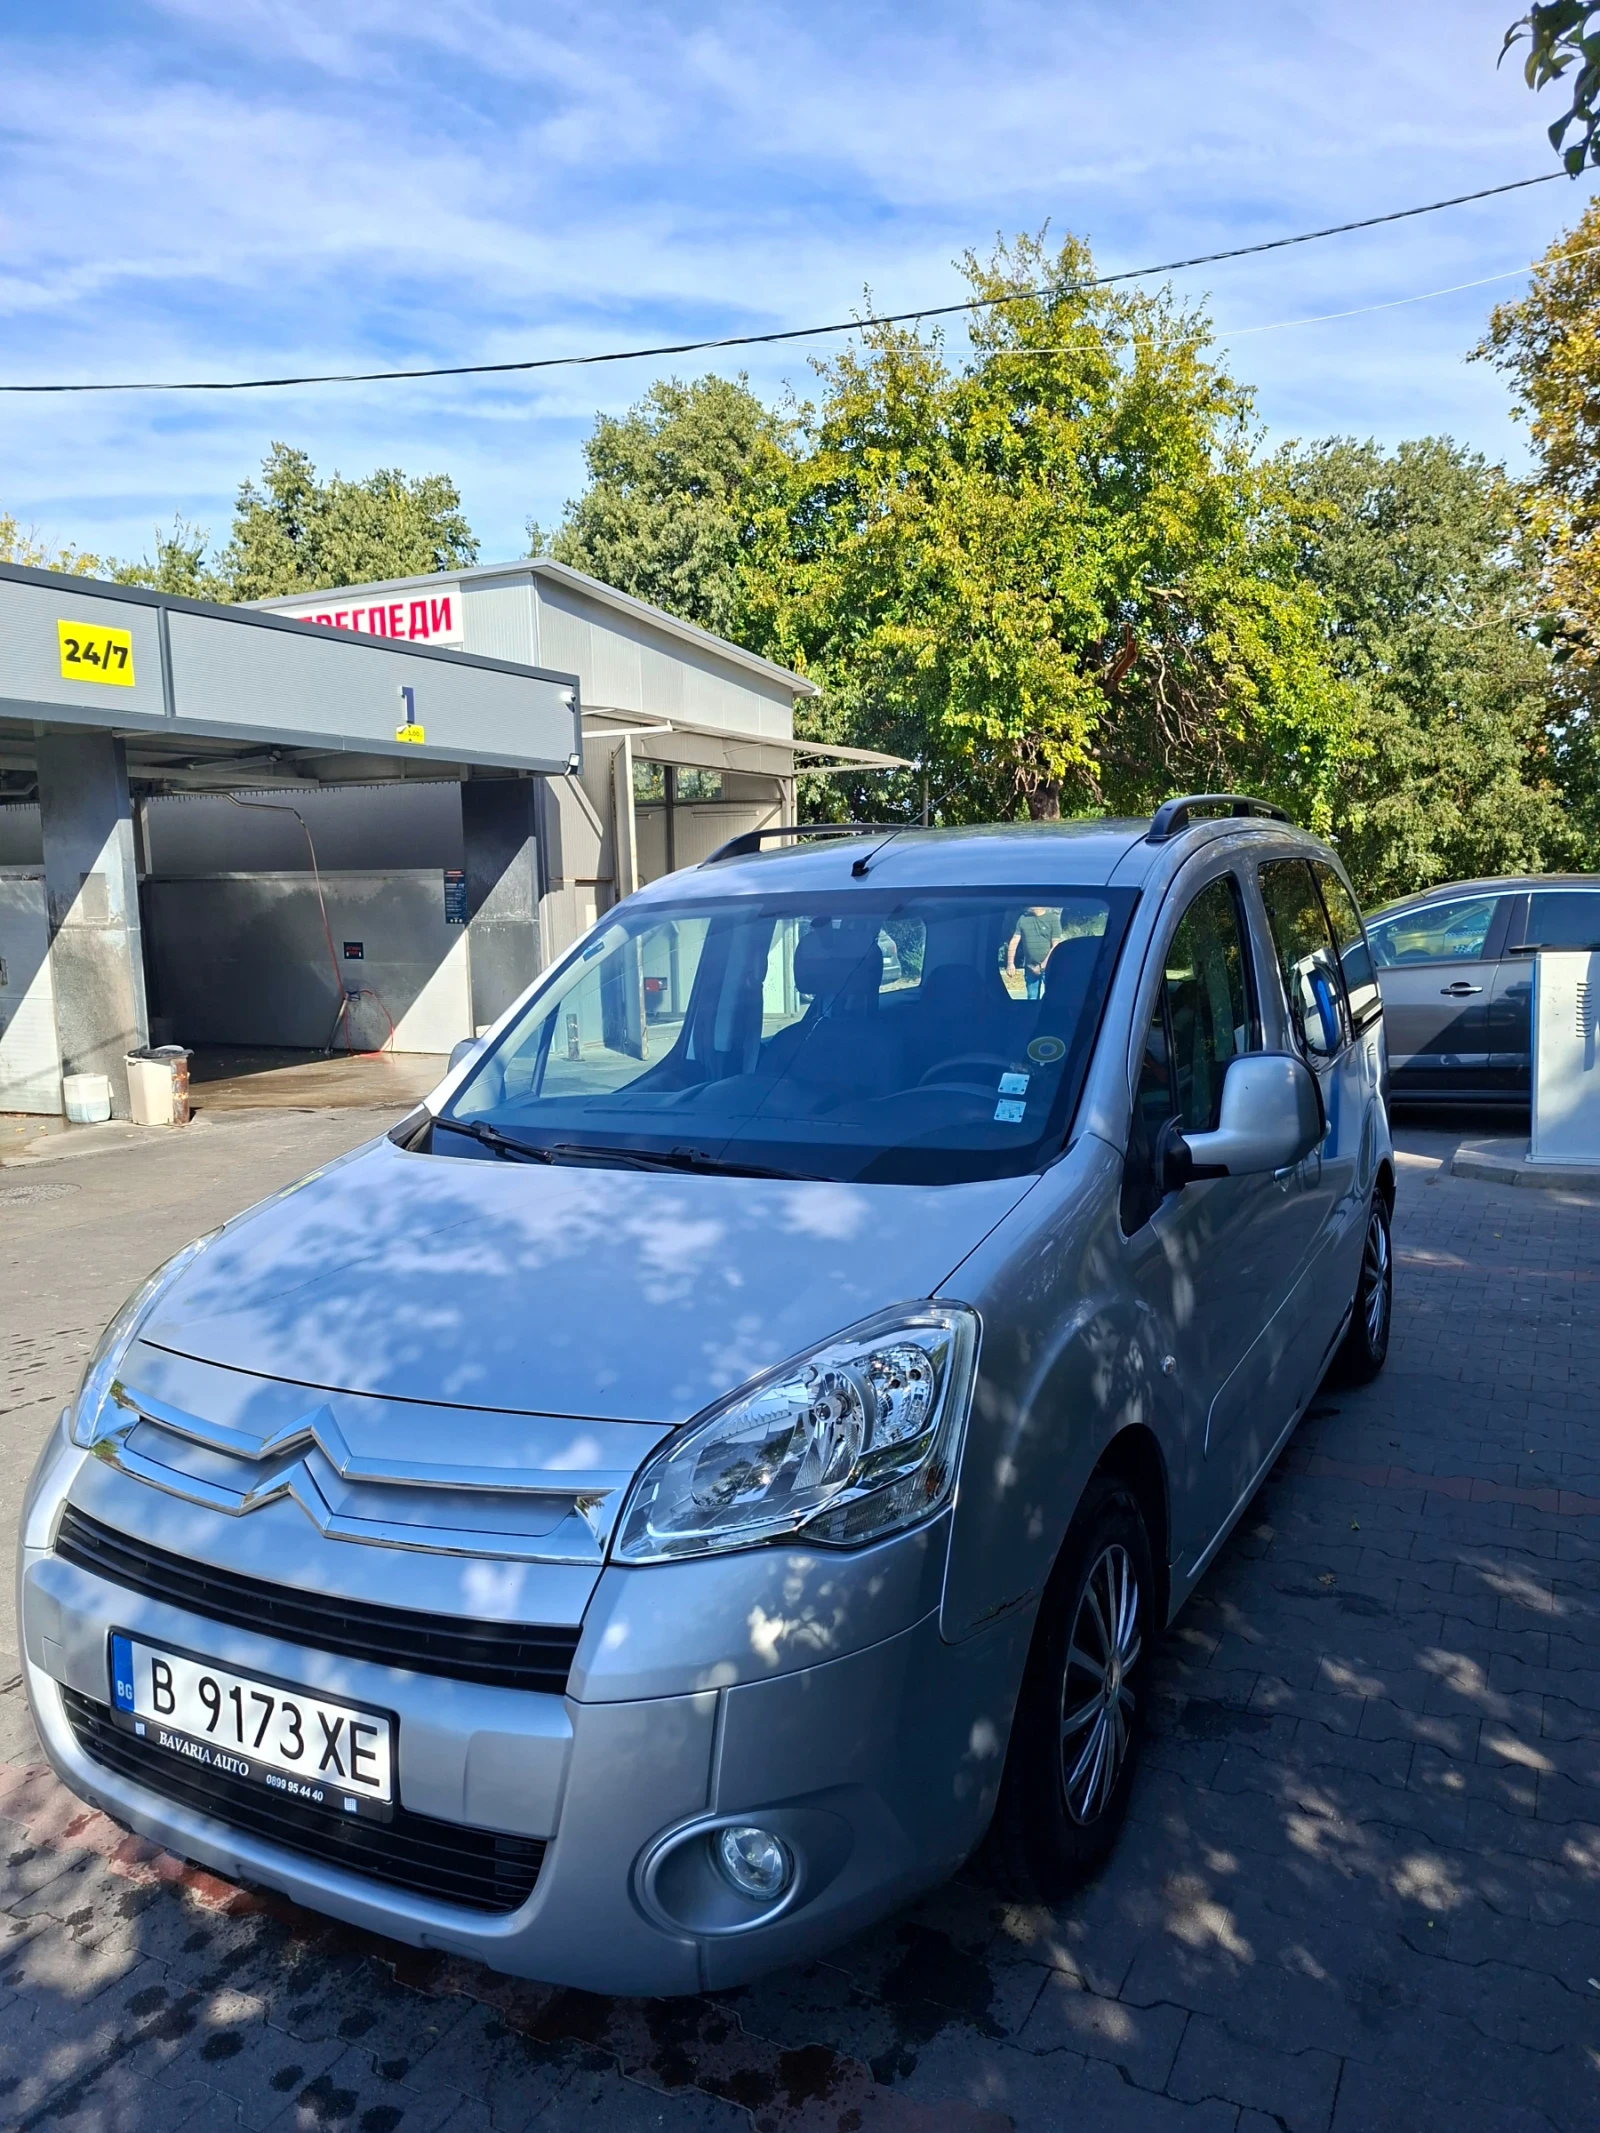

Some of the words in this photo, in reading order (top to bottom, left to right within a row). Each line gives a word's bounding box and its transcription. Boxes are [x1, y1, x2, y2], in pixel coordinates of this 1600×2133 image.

[64, 638, 128, 670] 24/7
[400, 685, 415, 725] 1
[117, 1680, 133, 1700] BG
[151, 1657, 176, 1715] B
[198, 1676, 305, 1760] 9173
[316, 1710, 380, 1788] XE
[159, 1731, 211, 1764] BAVARIA
[212, 1753, 249, 1776] AUTO
[266, 1774, 287, 1789] 0899
[287, 1781, 299, 1794] 95
[299, 1785, 311, 1798] 44
[311, 1790, 324, 1802] 40
